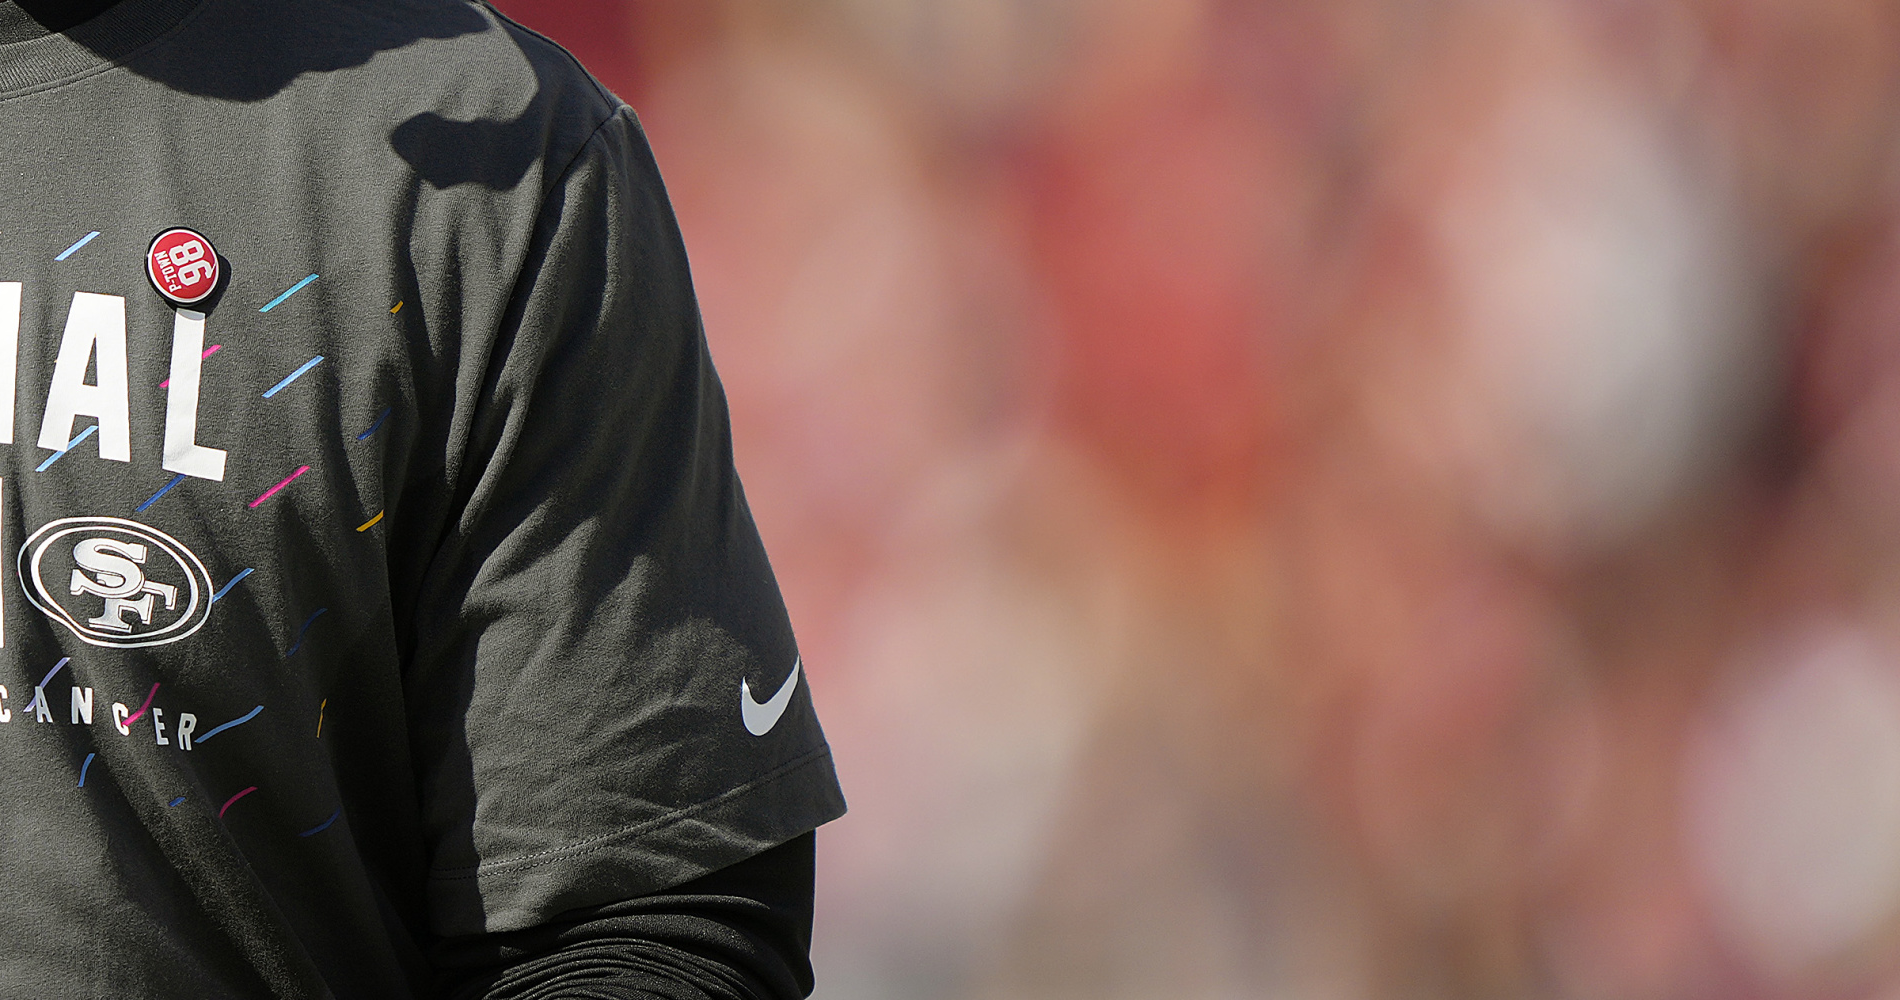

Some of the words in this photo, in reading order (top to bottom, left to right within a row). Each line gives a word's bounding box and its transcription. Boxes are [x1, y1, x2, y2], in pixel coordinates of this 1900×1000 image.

[153, 250, 182, 292] P-TOWN
[168, 239, 212, 286] 98
[70, 537, 178, 633] SF
